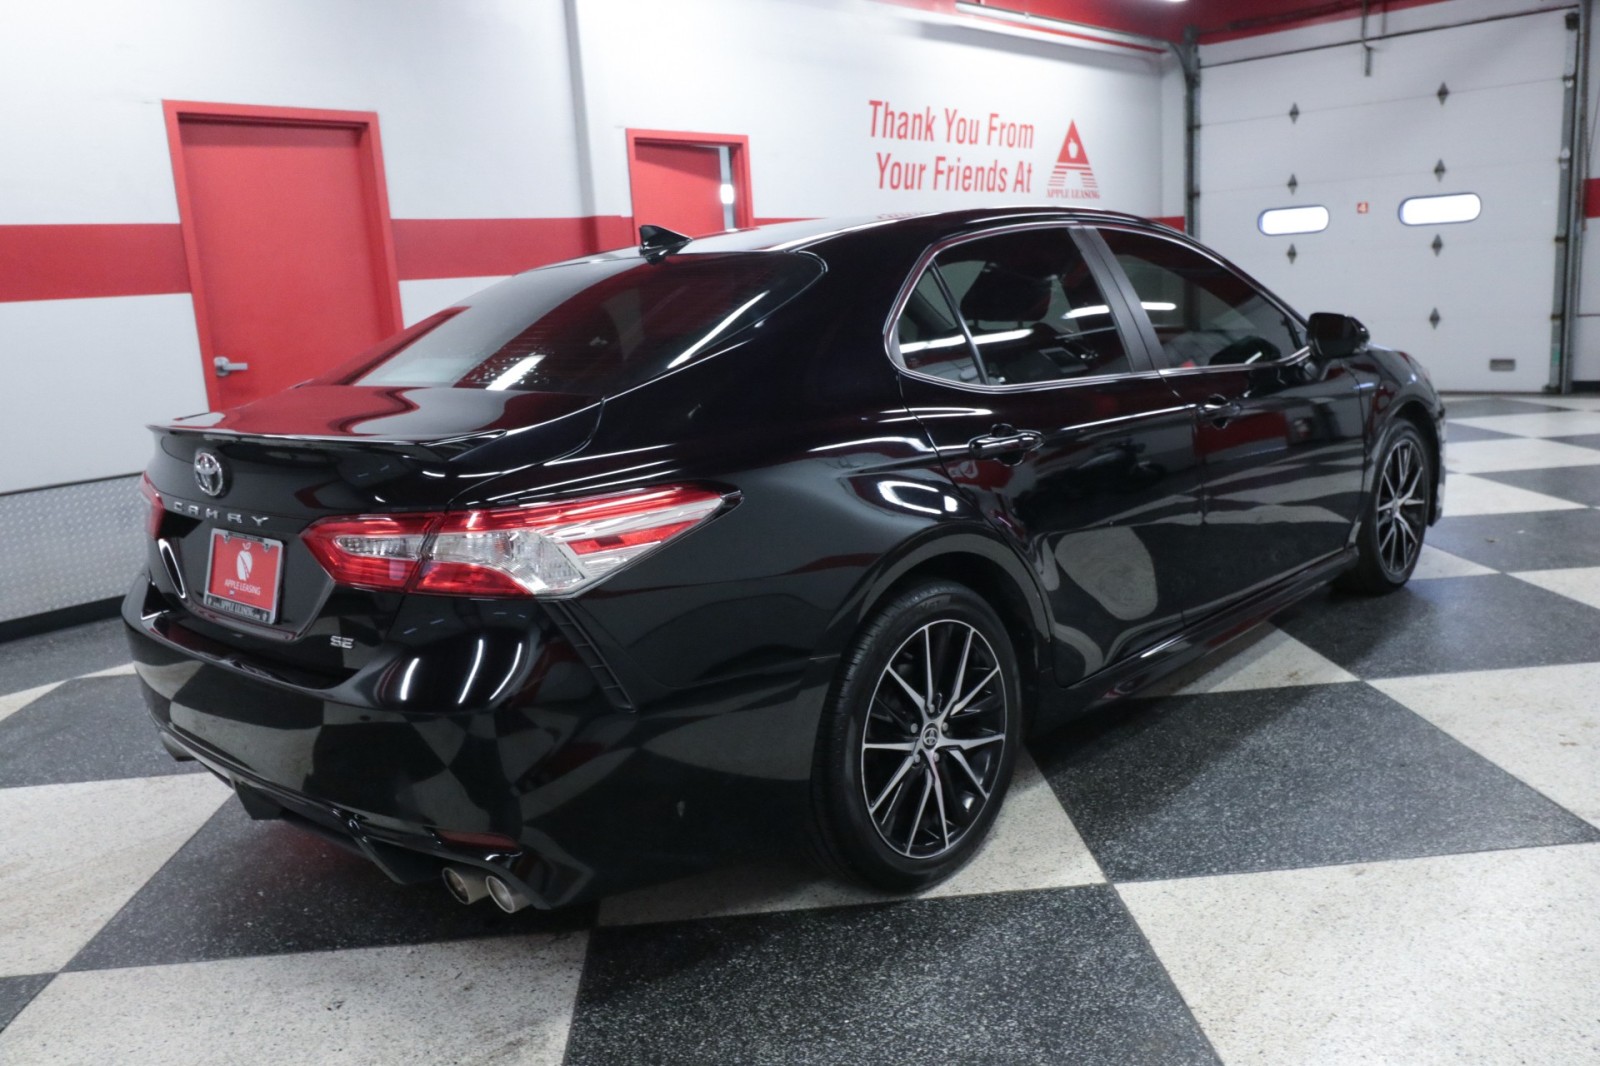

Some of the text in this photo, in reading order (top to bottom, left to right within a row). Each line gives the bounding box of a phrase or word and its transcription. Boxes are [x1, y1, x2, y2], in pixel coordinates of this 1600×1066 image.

[869, 99, 1035, 149] Thank You From
[876, 151, 1032, 193] Your Friends At
[1046, 187, 1100, 199] APPLE LEASING
[174, 501, 269, 526] CAMRY
[224, 578, 261, 596] APPLE LEASING
[330, 635, 354, 649] SE
